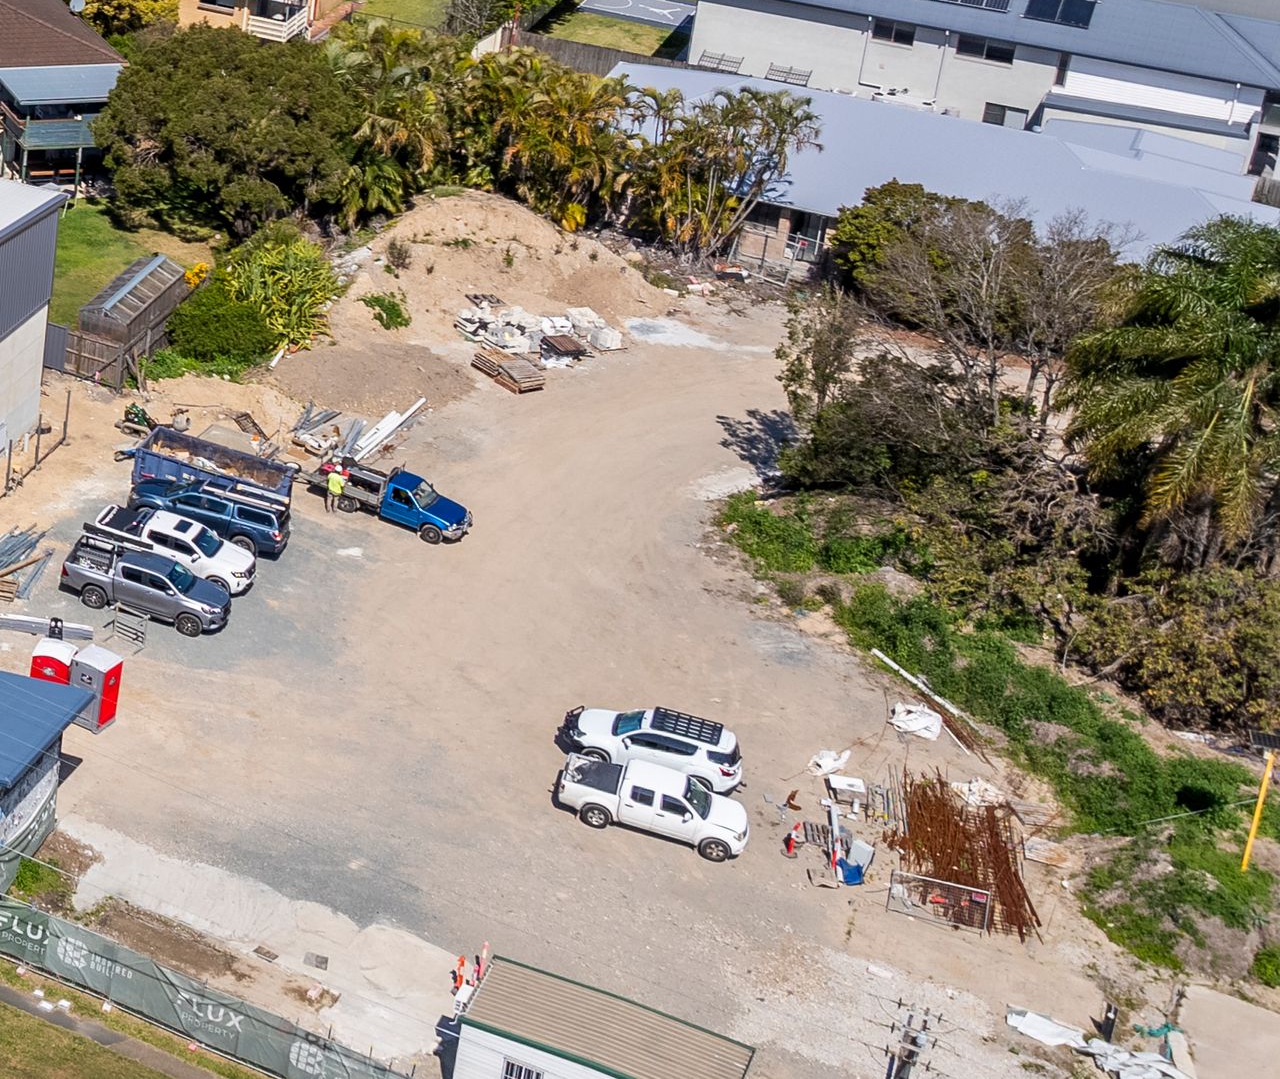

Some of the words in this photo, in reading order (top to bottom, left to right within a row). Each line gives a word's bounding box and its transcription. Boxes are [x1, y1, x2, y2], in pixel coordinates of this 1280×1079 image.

[1, 931, 46, 955] PROPERT
[90, 962, 114, 979] BUILT
[91, 953, 134, 980] INSPIRED
[176, 991, 245, 1033] FLUX
[181, 1011, 237, 1040] PROPERTY
